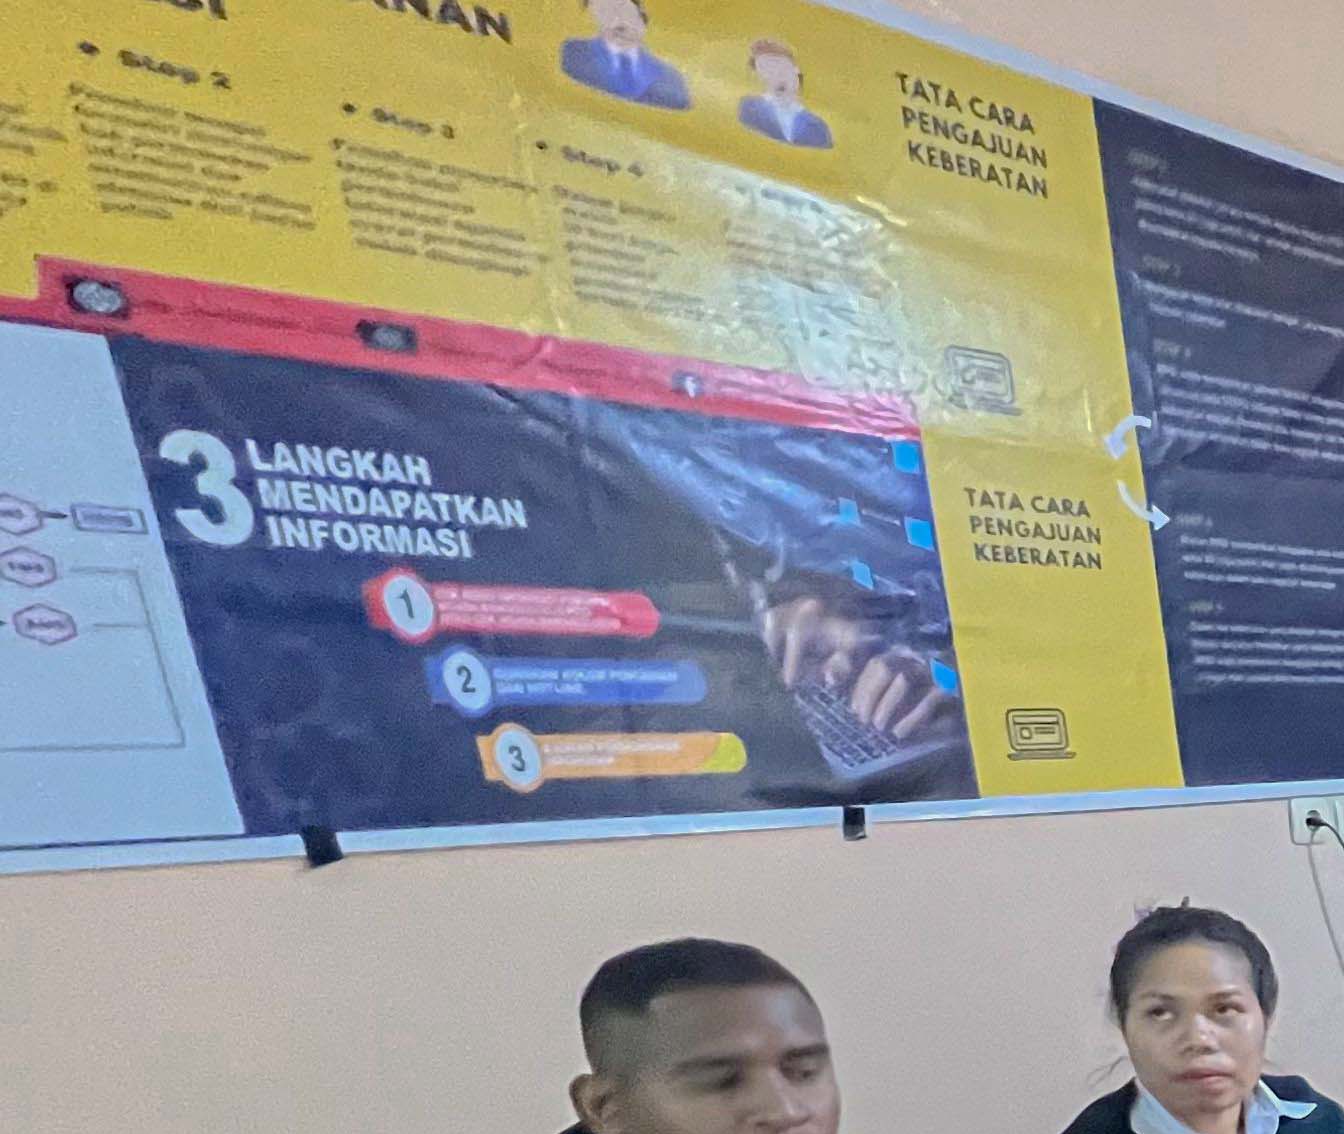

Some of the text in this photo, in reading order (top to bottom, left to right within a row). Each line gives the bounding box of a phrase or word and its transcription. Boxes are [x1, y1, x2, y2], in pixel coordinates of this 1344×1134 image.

[895, 71, 1036, 135] TATA CARA
[901, 105, 1048, 169] PENGAJUAN
[907, 139, 1048, 199] KEBERATAN
[158, 428, 432, 546] 3 LANGKAH
[256, 478, 528, 529] MENDAPATKAN
[964, 487, 1091, 519] TATA CARA
[265, 514, 473, 558] INFORMASI
[969, 514, 1102, 546] PENGAJUAN
[973, 542, 1103, 571] KEBERATAN
[400, 588, 415, 620] 1
[456, 665, 476, 694] 2
[507, 744, 527, 773] 3
